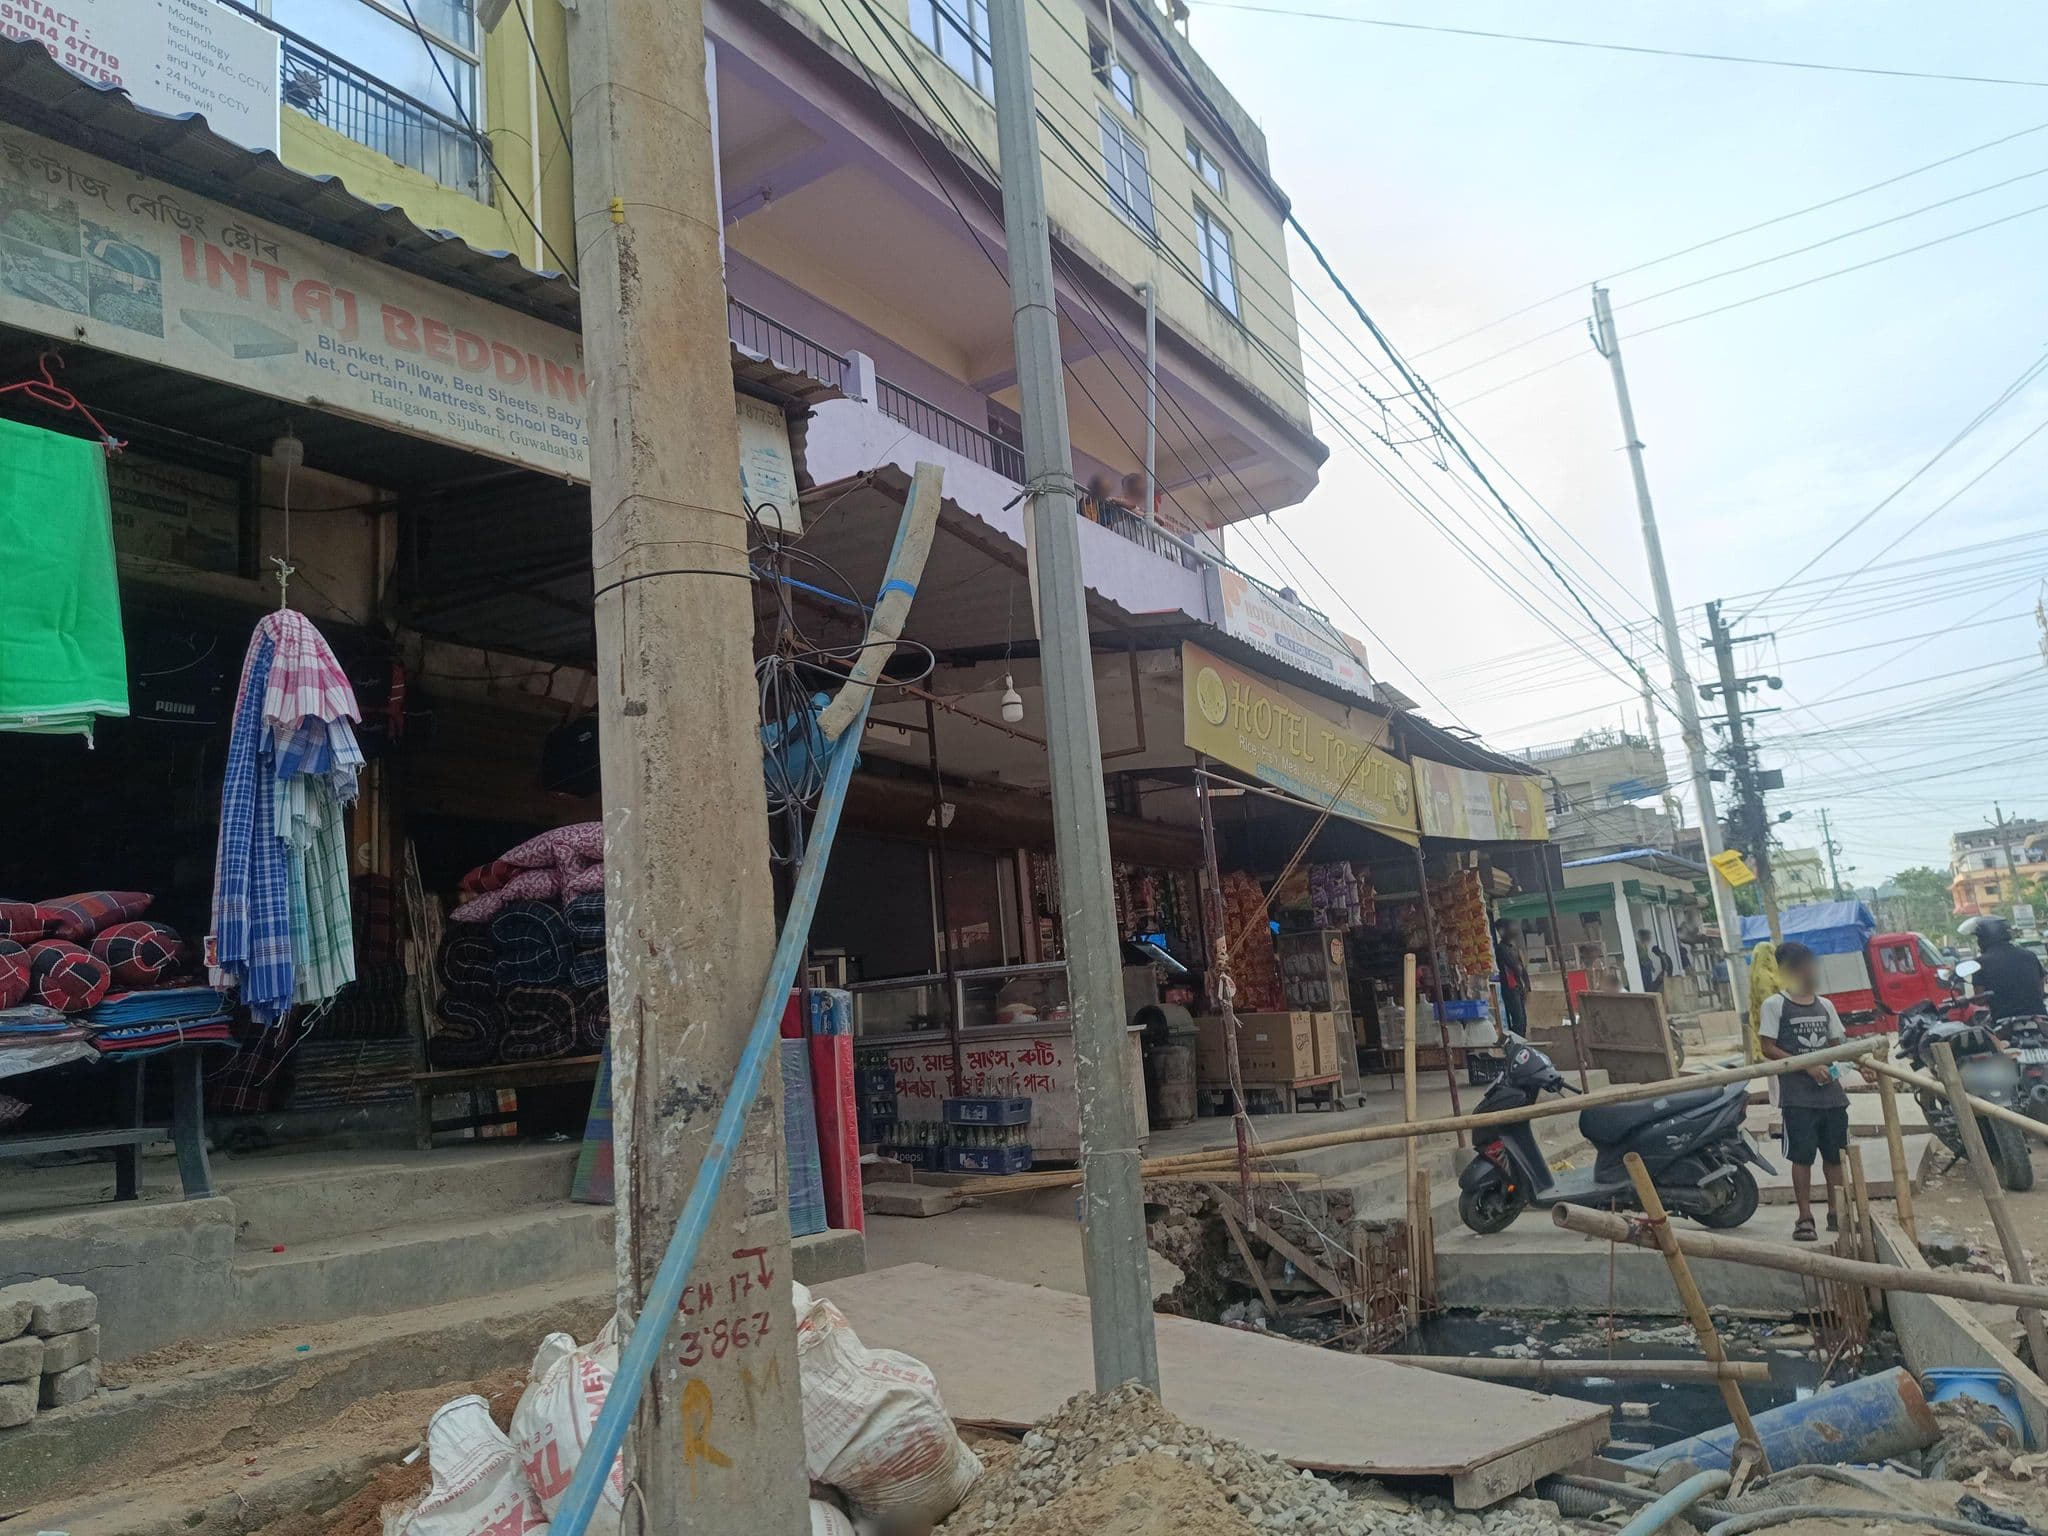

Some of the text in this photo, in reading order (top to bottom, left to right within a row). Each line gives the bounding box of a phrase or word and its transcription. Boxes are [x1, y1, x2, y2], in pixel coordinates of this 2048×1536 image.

[168, 6, 212, 34] Modern
[65, 36, 119, 69] 47719
[167, 38, 214, 67] includes
[168, 22, 230, 60] technology
[167, 54, 207, 78] and TV
[165, 83, 191, 101] Free
[166, 67, 250, 114] 24 hours CCTV
[180, 234, 360, 342] INTAJ
[305, 350, 578, 446] Net, Curtain, Mattress, School Bag
[318, 334, 582, 429] Blanket, Pillow, Bed Sheets, Baby
[372, 390, 443, 424] Hatigaon,
[447, 411, 505, 441] Sijubari,
[1232, 678, 1315, 764] HOTEL
[730, 1271, 753, 1303] 17
